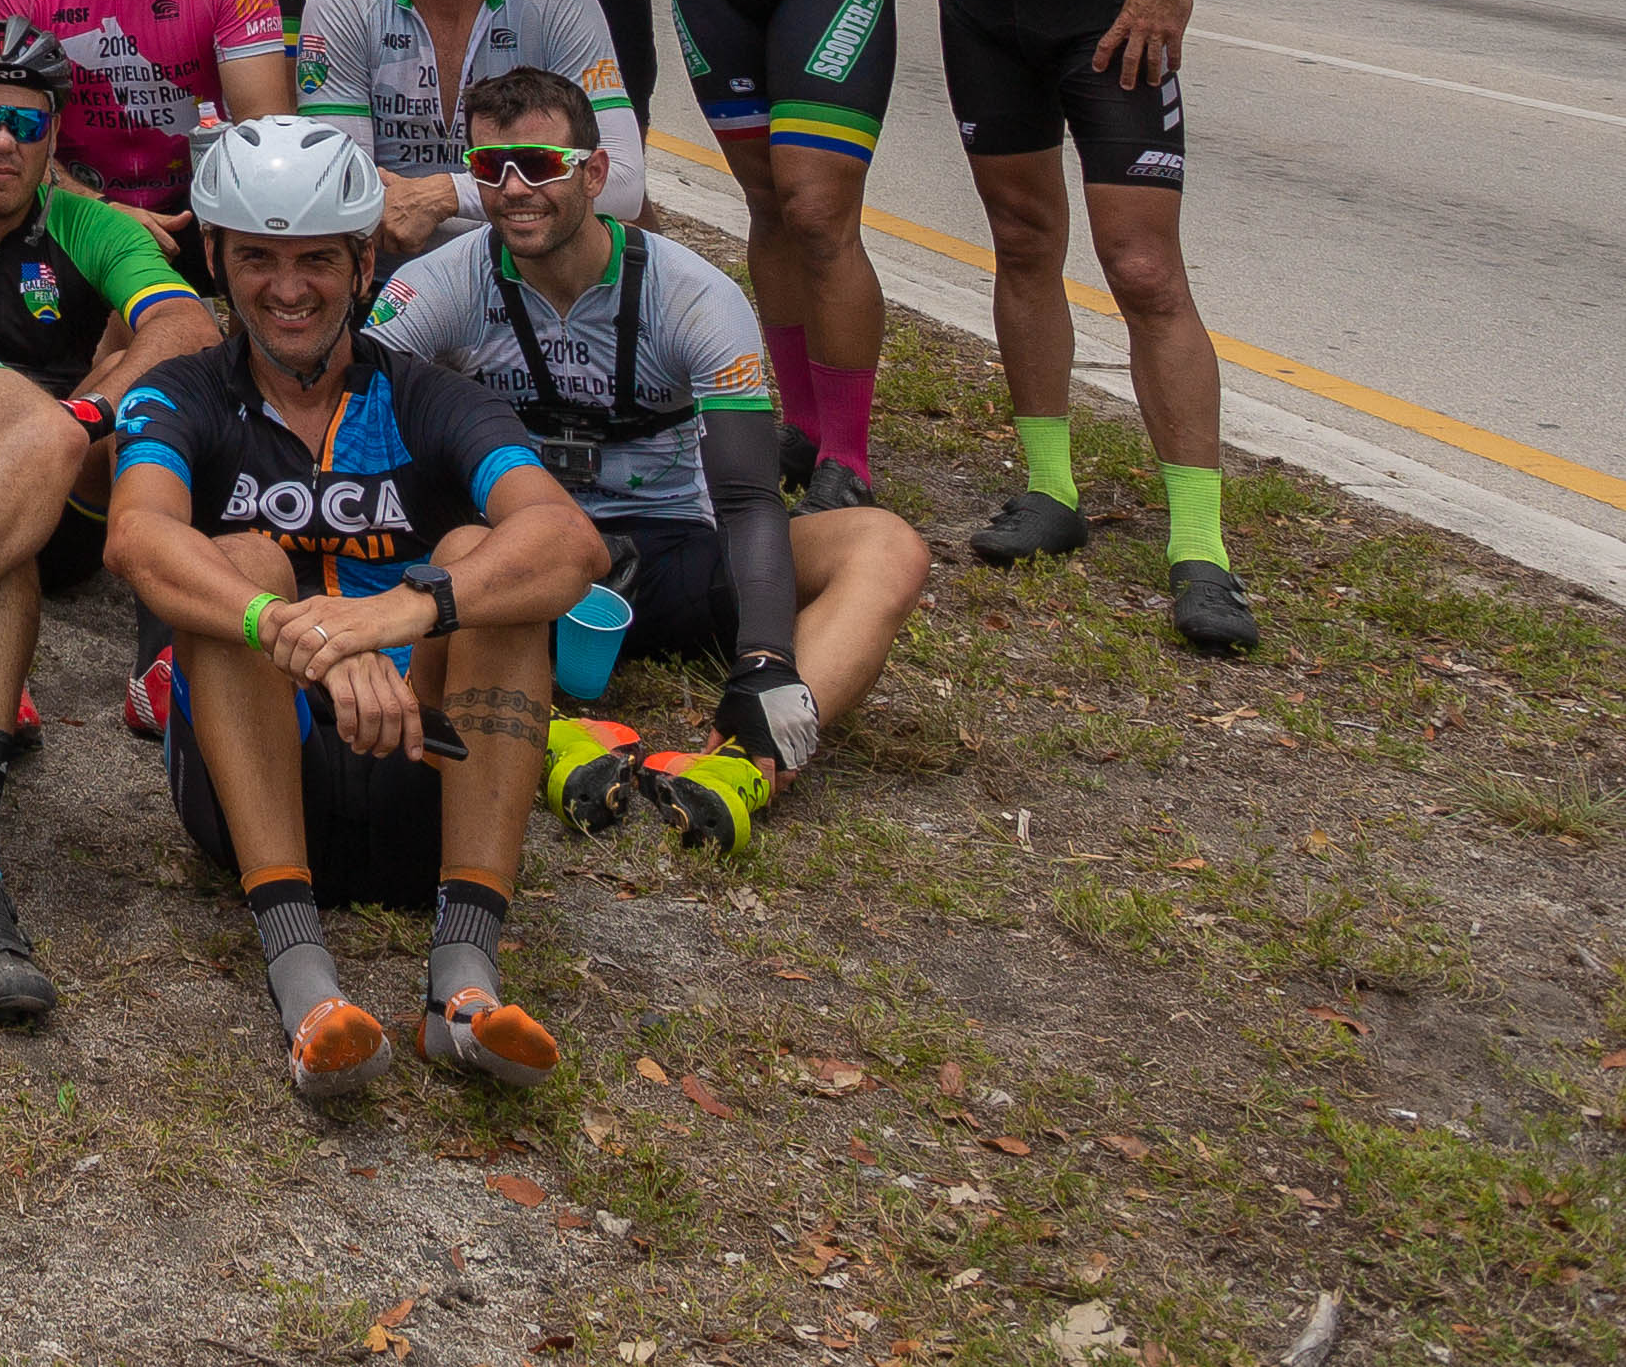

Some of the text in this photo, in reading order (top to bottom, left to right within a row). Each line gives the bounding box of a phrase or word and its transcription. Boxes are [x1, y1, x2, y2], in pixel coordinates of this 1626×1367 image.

[99, 35, 139, 59] 2018
[812, 2, 874, 81] SCOOTER
[76, 59, 201, 85] DEERFIELD BEACH
[79, 85, 194, 108] KEY WEST RIDE
[83, 108, 175, 130] 215 MILES
[397, 119, 431, 140] KEY
[399, 144, 434, 164] 215
[268, 220, 287, 229] BELL
[540, 336, 590, 366] 2018
[220, 472, 414, 533] BOCA
